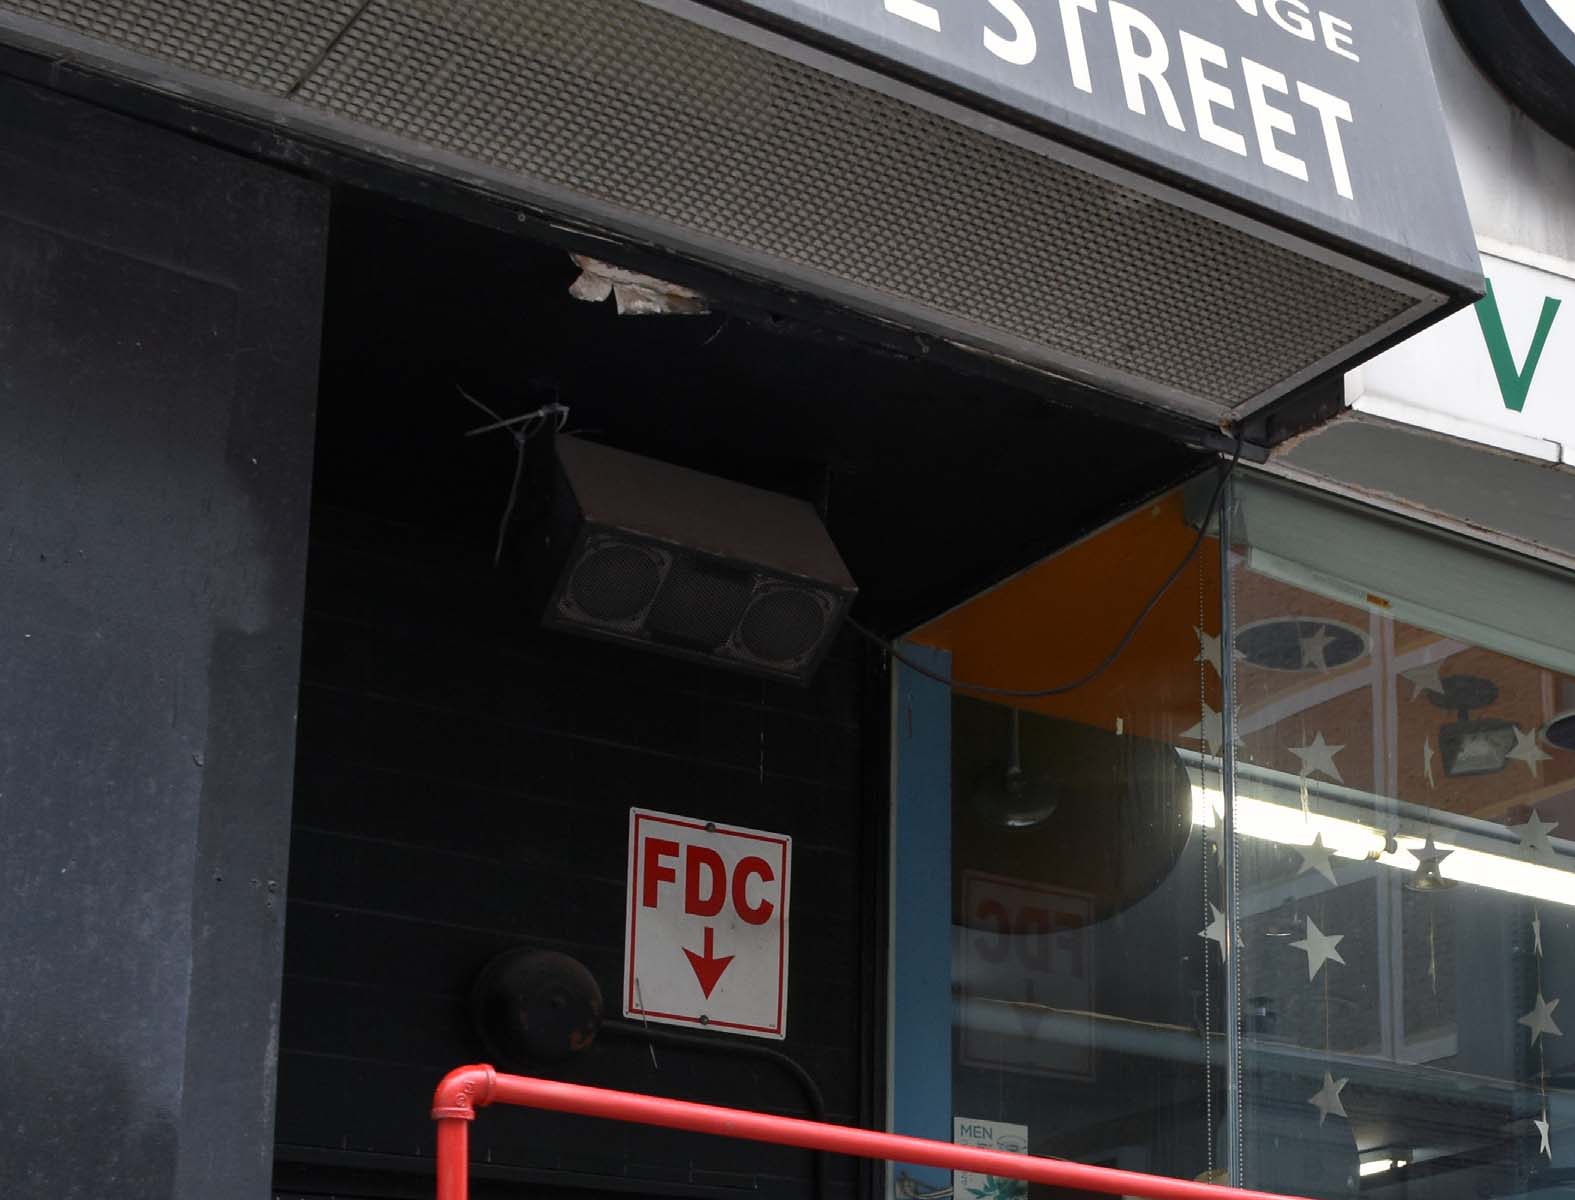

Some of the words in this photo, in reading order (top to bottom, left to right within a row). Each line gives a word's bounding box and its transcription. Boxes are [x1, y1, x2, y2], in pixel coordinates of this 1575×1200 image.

[983, 0, 1354, 201] STREET
[642, 836, 775, 926] FDC
[960, 1125, 992, 1139] MEN
